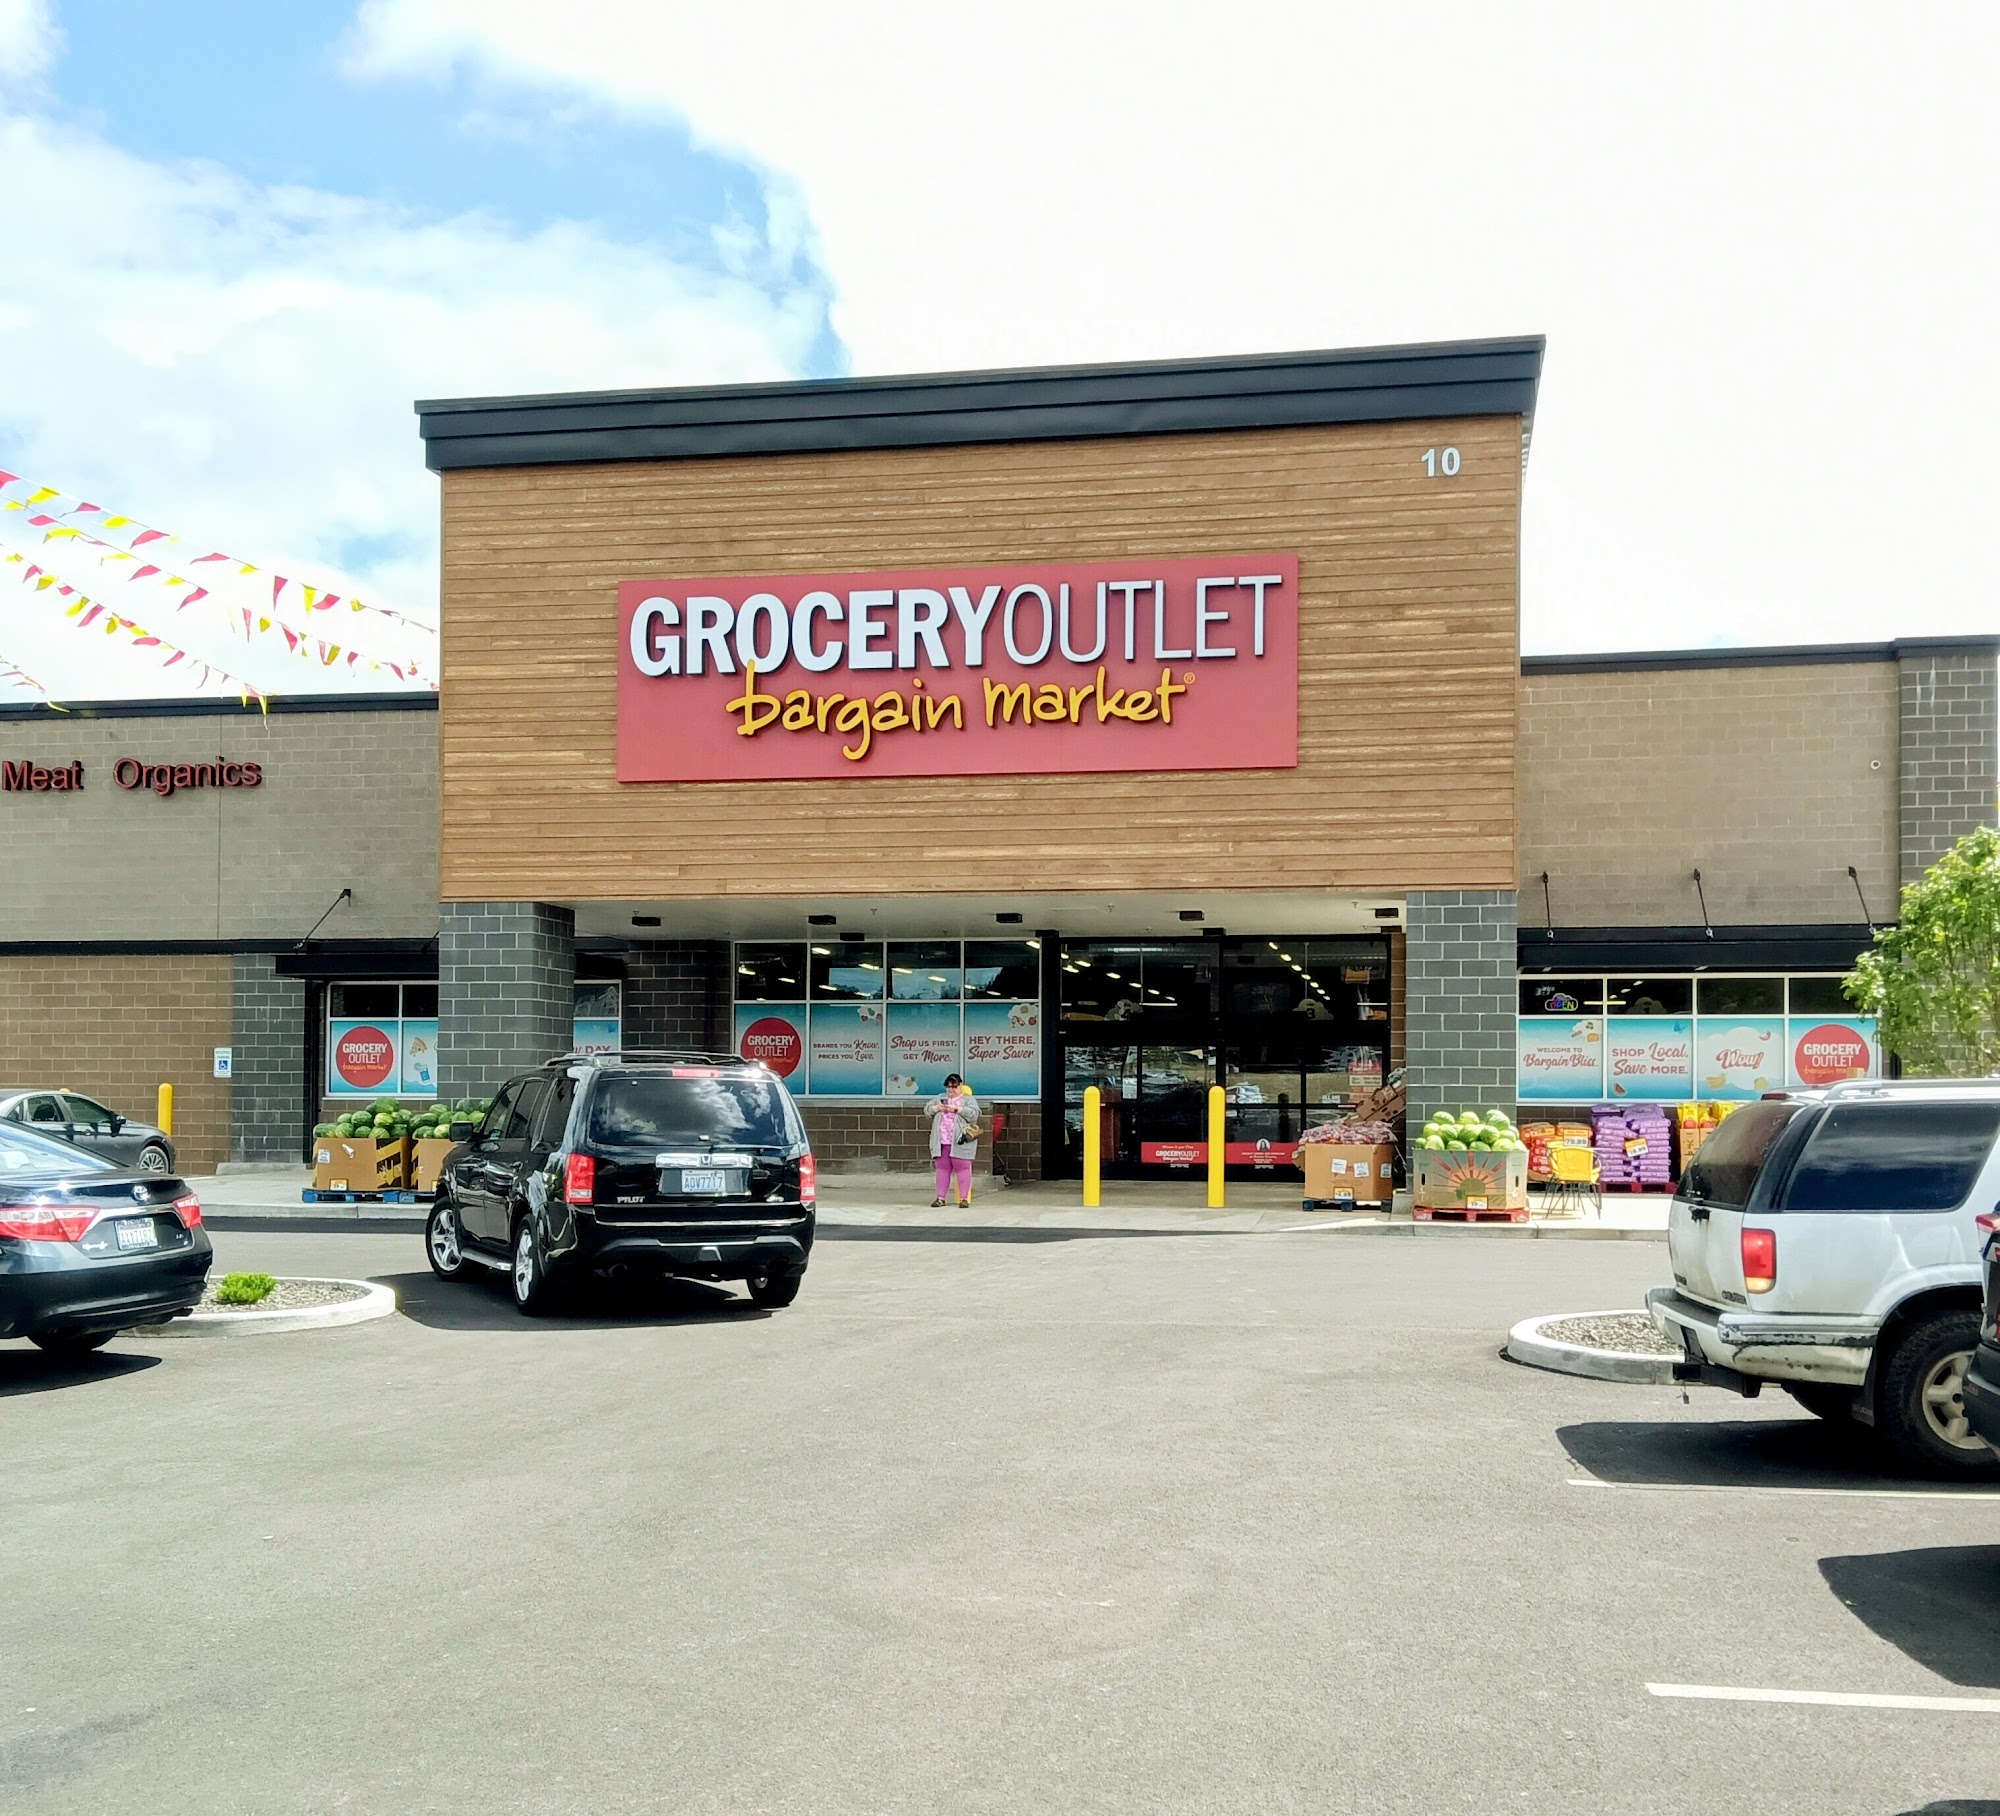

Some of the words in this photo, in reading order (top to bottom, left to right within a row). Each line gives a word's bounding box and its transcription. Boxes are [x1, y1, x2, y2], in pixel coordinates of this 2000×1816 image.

[1421, 447, 1460, 477] 10
[726, 660, 963, 761] bargain
[2, 760, 84, 791] Meat
[113, 756, 262, 796] Organics
[1550, 1000, 1575, 1009] OPEN
[342, 1043, 387, 1053] GROCERY
[747, 1035, 795, 1046] GROCERY
[890, 1035, 917, 1051] Shop
[968, 1036, 992, 1045] HEY
[995, 1036, 1036, 1046] THERE,
[754, 1045, 788, 1057] OUTLET
[921, 1049, 952, 1063] More.
[967, 1045, 1000, 1062] Super
[1002, 1045, 1034, 1060] Saver
[1612, 1048, 1645, 1057] SHOP
[1648, 1042, 1688, 1061] Local.
[1803, 1043, 1861, 1055] GROCERY
[348, 1053, 381, 1064] OUTLET
[1522, 1053, 1569, 1071] Bargain
[1569, 1053, 1598, 1067] Bliss
[1716, 1049, 1764, 1069] Wow!
[1811, 1055, 1854, 1067] OUTLET
[1613, 1059, 1647, 1076] Save
[1650, 1065, 1688, 1074] MORE.
[616, 1196, 646, 1204] PILOT
